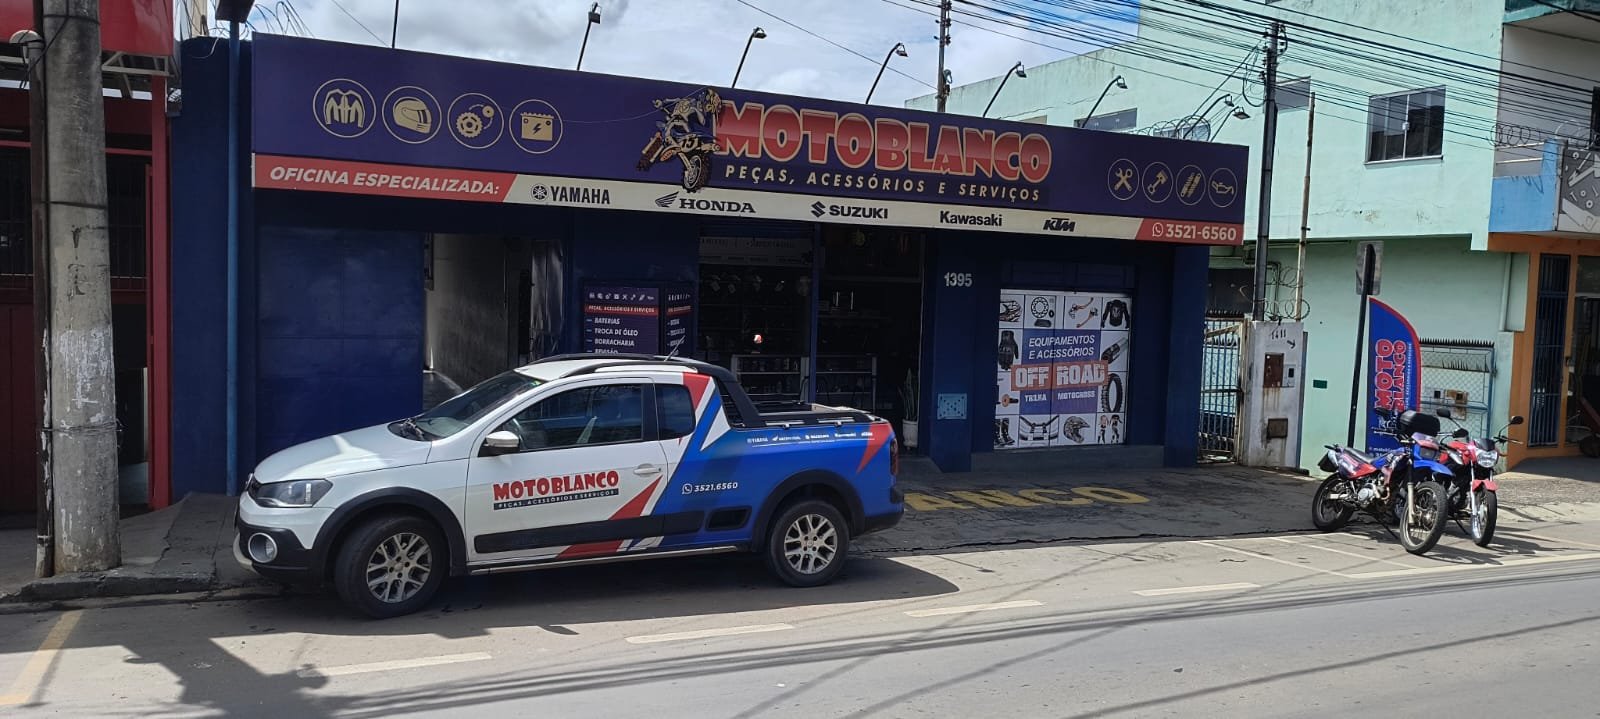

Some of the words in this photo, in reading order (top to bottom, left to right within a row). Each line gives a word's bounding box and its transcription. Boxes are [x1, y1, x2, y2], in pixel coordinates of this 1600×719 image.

[714, 100, 1052, 184] MOTOBLANCO
[270, 166, 349, 186] OFICINA
[353, 172, 500, 195] ESPECIALIZADA:
[725, 164, 794, 186] PEÇAS,
[807, 172, 925, 194] ACESSÓRIOS
[938, 182, 947, 195] E
[959, 182, 1040, 203] SERVIÇOS
[550, 185, 611, 205] YAMAHA
[679, 198, 756, 214] HONDA
[829, 204, 889, 219] SUZUKI
[940, 210, 1003, 227] Kawasaki
[1043, 218, 1076, 232] KTM
[1165, 222, 1237, 241] 3521-6560
[943, 272, 973, 287] 1395
[594, 317, 620, 325] BATERIAS
[614, 328, 622, 336] DE
[623, 328, 639, 336] ÓLEO
[594, 338, 635, 347] BORRACHARIA
[1028, 335, 1095, 347] EQUIPAMENTOS
[1028, 350, 1035, 360] E
[1036, 346, 1095, 359] ACESSÓRIOS
[1015, 366, 1050, 388] OFF
[1056, 363, 1105, 386] ROAD
[1375, 338, 1394, 409] MOTO
[1392, 340, 1407, 412] BLANCO
[1057, 391, 1096, 400] MOTOCROSS
[493, 470, 619, 502] MOTOBLANCO
[694, 482, 739, 493] 3521.6560
[527, 494, 573, 506] ACESSÓRIOS
[904, 486, 1151, 511] ANCO
